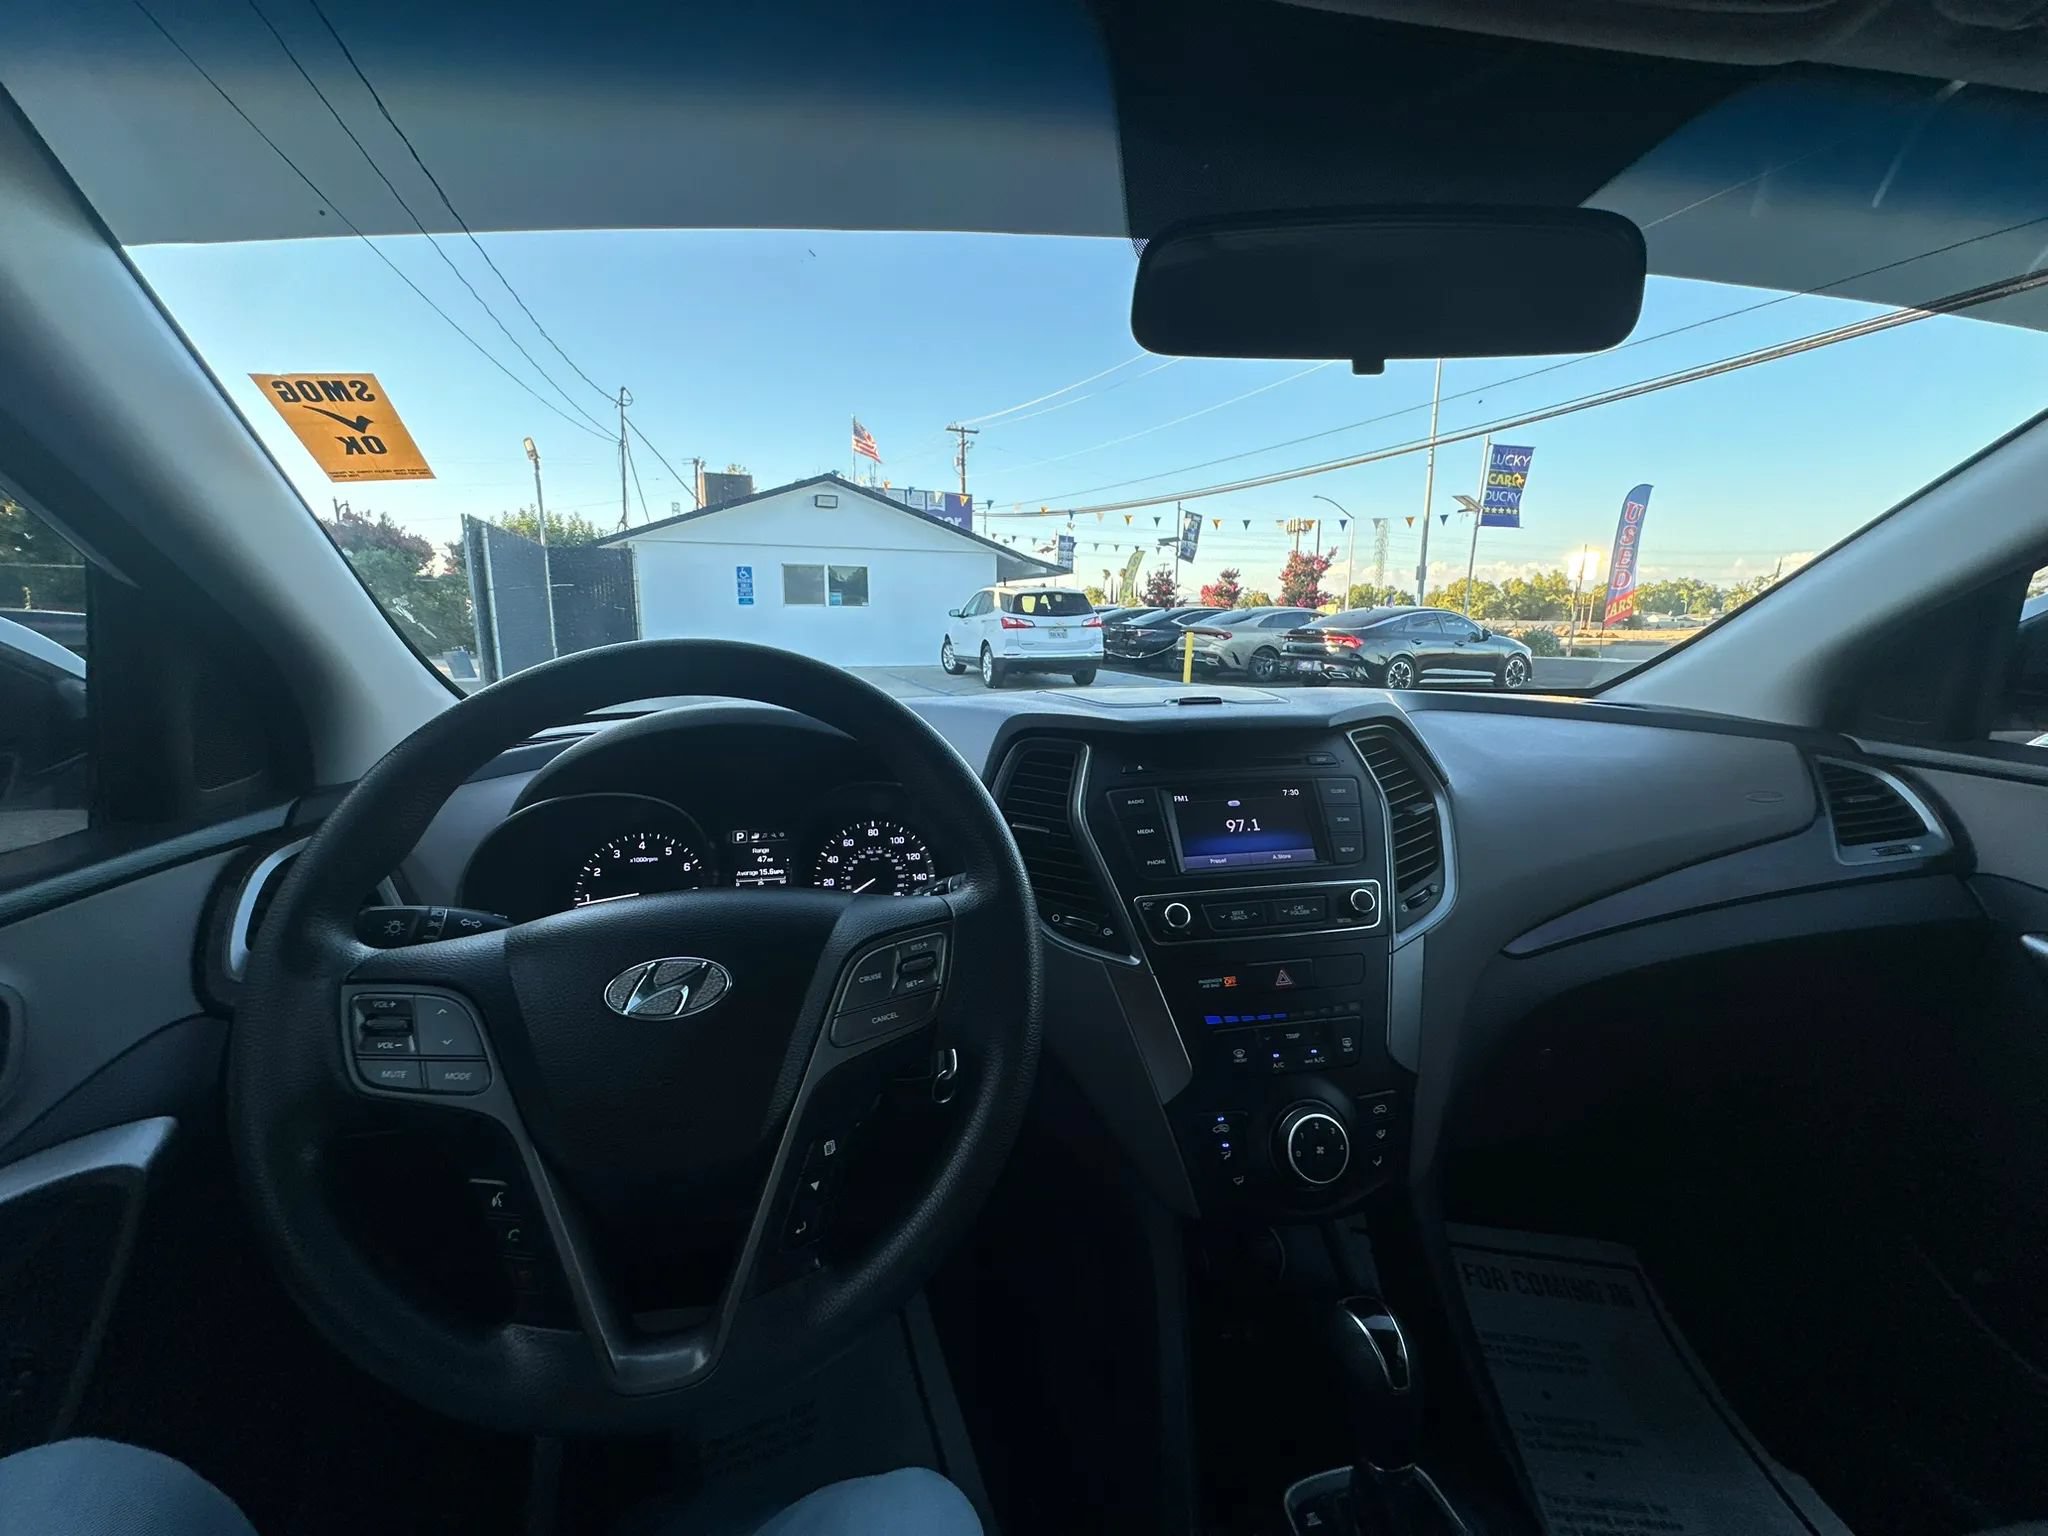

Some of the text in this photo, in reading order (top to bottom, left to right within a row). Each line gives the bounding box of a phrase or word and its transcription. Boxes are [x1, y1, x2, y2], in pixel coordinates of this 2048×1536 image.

[1491, 453, 1532, 467] LUCKY
[1611, 501, 1645, 590] USED
[1282, 788, 1300, 796] 7:30
[1225, 818, 1261, 832] 97.1
[736, 832, 745, 842] P
[867, 828, 879, 837] 80
[842, 838, 855, 847] 60
[890, 836, 905, 845] 100
[638, 841, 646, 850] 4
[613, 849, 621, 858] 3
[665, 846, 673, 856] 5
[827, 855, 839, 864] 40
[905, 852, 921, 861] 120
[683, 862, 691, 872] 6
[593, 867, 601, 877] 2
[912, 872, 927, 881] 140
[823, 878, 835, 887] 20
[871, 1012, 899, 1024] CANCEL
[380, 1070, 408, 1079] MUTE
[444, 1072, 473, 1081] MODE
